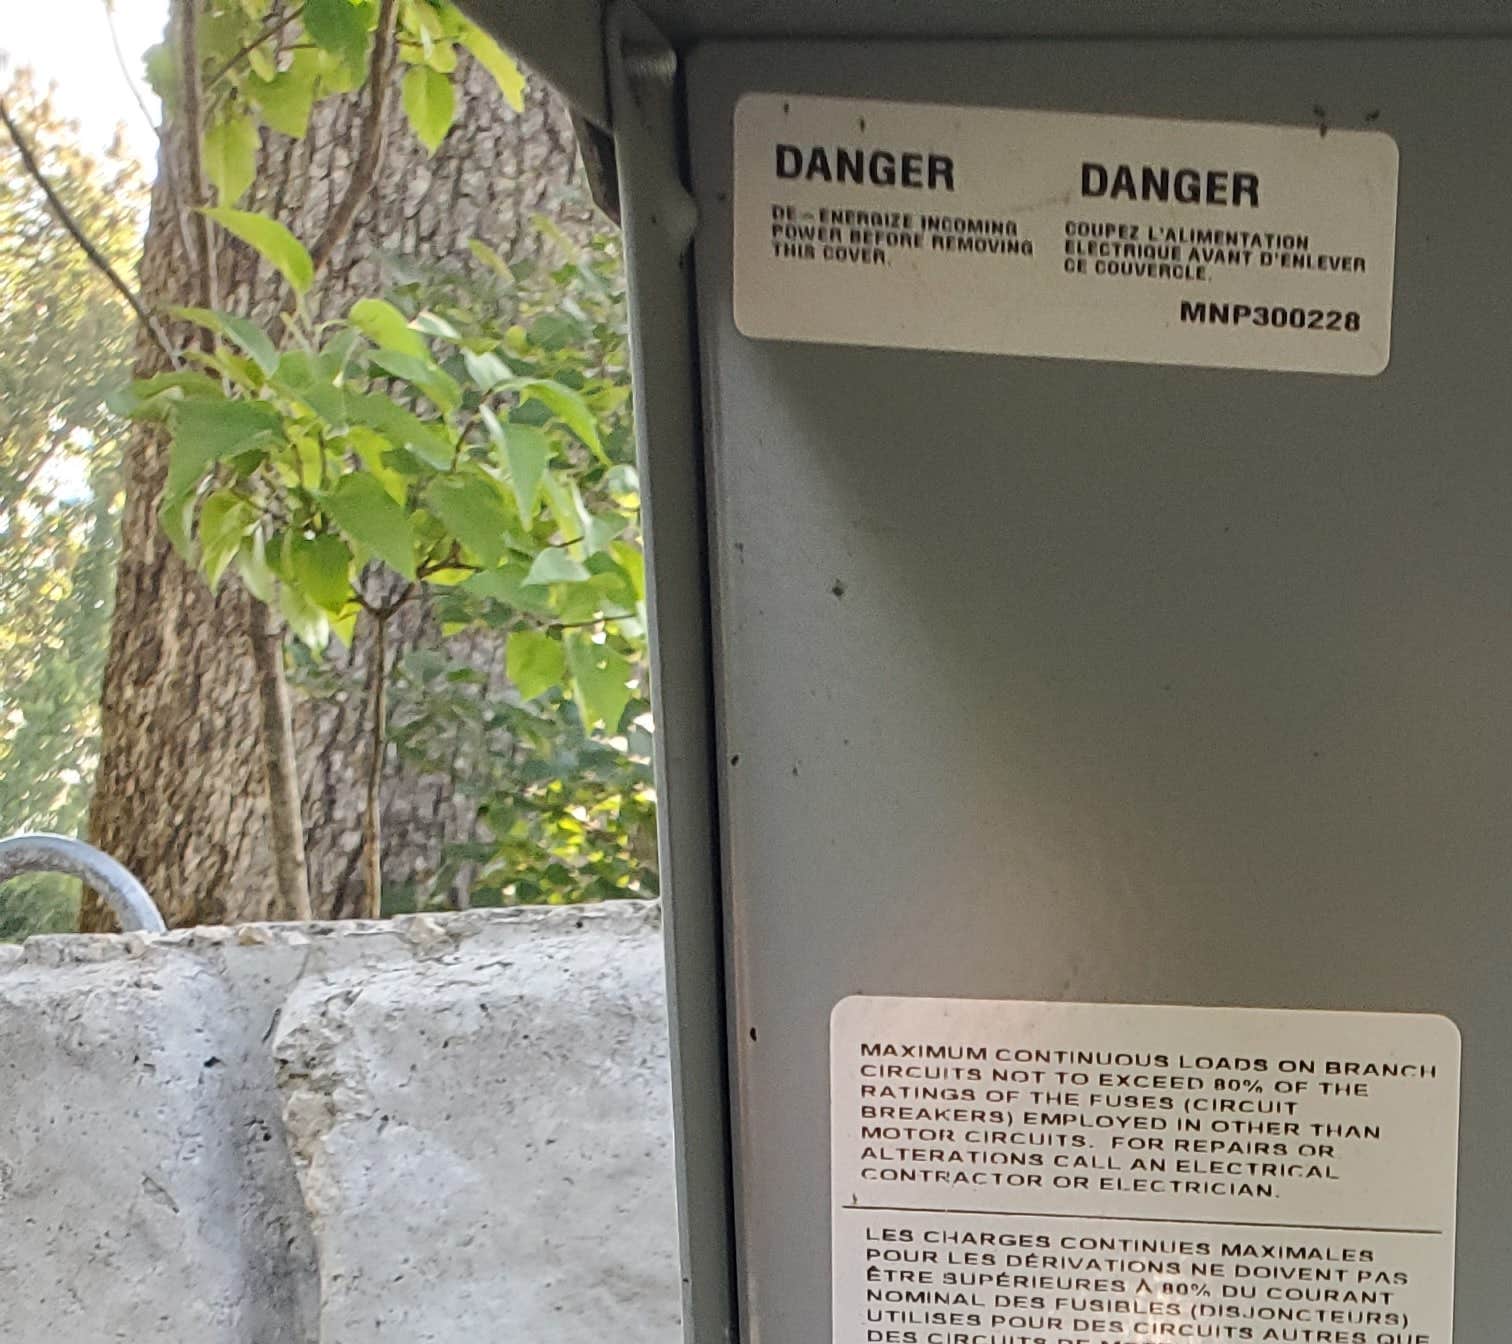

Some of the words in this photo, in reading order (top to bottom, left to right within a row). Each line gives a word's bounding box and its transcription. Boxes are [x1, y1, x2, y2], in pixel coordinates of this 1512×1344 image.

[775, 143, 955, 193] DANGER
[1081, 161, 1260, 209] DANGER
[771, 222, 843, 245] POWER
[849, 227, 925, 250] BEFORE
[931, 233, 1034, 257] REMOVING
[919, 214, 1018, 238] INCOMING
[1064, 219, 1140, 242] COUPEZ
[1147, 224, 1309, 253] L'ALIMENTATION
[771, 239, 816, 261] THIS
[822, 243, 892, 267] COVER.
[1187, 246, 1254, 268] AVANT
[1259, 250, 1366, 274] D'ENLEVER
[1094, 258, 1213, 283] COUVERCLE.
[1180, 299, 1361, 333] MNP300228
[860, 1042, 987, 1061] MAXIMUM
[995, 1048, 1169, 1068] CONTINUOUS
[1179, 1054, 1269, 1073] LOADS
[1277, 1059, 1315, 1075] ON
[1325, 1060, 1437, 1079] BRANCH
[859, 1063, 982, 1081] CIRCUITS
[992, 1067, 1047, 1085] NOT
[1054, 1071, 1090, 1086] TO
[1098, 1072, 1204, 1091] EXCEED
[1213, 1077, 1264, 1095] 80%
[1273, 1079, 1309, 1095] OF
[1318, 1081, 1369, 1098] THE
[860, 1084, 976, 1102] RATINGS
[985, 1089, 1020, 1104] OF
[1029, 1090, 1080, 1107] THE
[1089, 1092, 1174, 1111] FUSES
[1183, 1097, 1299, 1116] (CIRCUIT
[861, 1104, 1014, 1128] BREAKERS)
[1023, 1111, 1168, 1131] EMPLOYED
[1177, 1116, 1201, 1132] IN
[1210, 1119, 1301, 1137] OTHER
[1309, 1122, 1380, 1140] THAN
[861, 1125, 956, 1143] MOTOR
[964, 1129, 1095, 1149] CIRCUITS.
[1111, 1135, 1165, 1152] FOR
[1174, 1138, 1289, 1156] REPAIRS
[1297, 1143, 1335, 1159] OR
[860, 1146, 1044, 1167] ALTERATIONS
[1053, 1154, 1122, 1171] CALL
[1129, 1157, 1166, 1173] AN
[1175, 1159, 1340, 1180] ELECTRICAL
[860, 1167, 1043, 1188] CONTRACTOR
[1052, 1175, 1089, 1190] OR
[1099, 1176, 1280, 1199] ELECTRICIAN.
[865, 1226, 915, 1243] LES
[923, 1229, 1051, 1249] CHARGES
[1060, 1236, 1211, 1256] CONTINUES
[1220, 1242, 1374, 1263] MAXIMALES
[866, 1247, 939, 1264] POUR
[947, 1250, 997, 1267] LES
[1006, 1252, 1182, 1276] DÉRIVATIONS
[1191, 1261, 1225, 1278] NE
[1234, 1263, 1349, 1283] DOIVENT
[1357, 1269, 1409, 1286] PAS
[866, 1264, 934, 1285] ÊTRE
[942, 1271, 1126, 1293] SUPÉRIEURES
[1161, 1281, 1211, 1298] 80%
[1221, 1283, 1257, 1300] DU
[1266, 1286, 1395, 1306] COURANT
[866, 1287, 986, 1308] NOMINAL
[994, 1293, 1046, 1310] DES
[1055, 1296, 1182, 1317] FUSIBLES
[1190, 1302, 1409, 1330] (DISJONCTEURS)
[867, 1307, 982, 1327] UTILISES
[991, 1314, 1064, 1331] POUR
[1072, 1317, 1124, 1334] DES
[1133, 1319, 1254, 1340] CIRCUITS
[1262, 1327, 1367, 1344] AUTRES
[867, 1328, 918, 1344] DES
